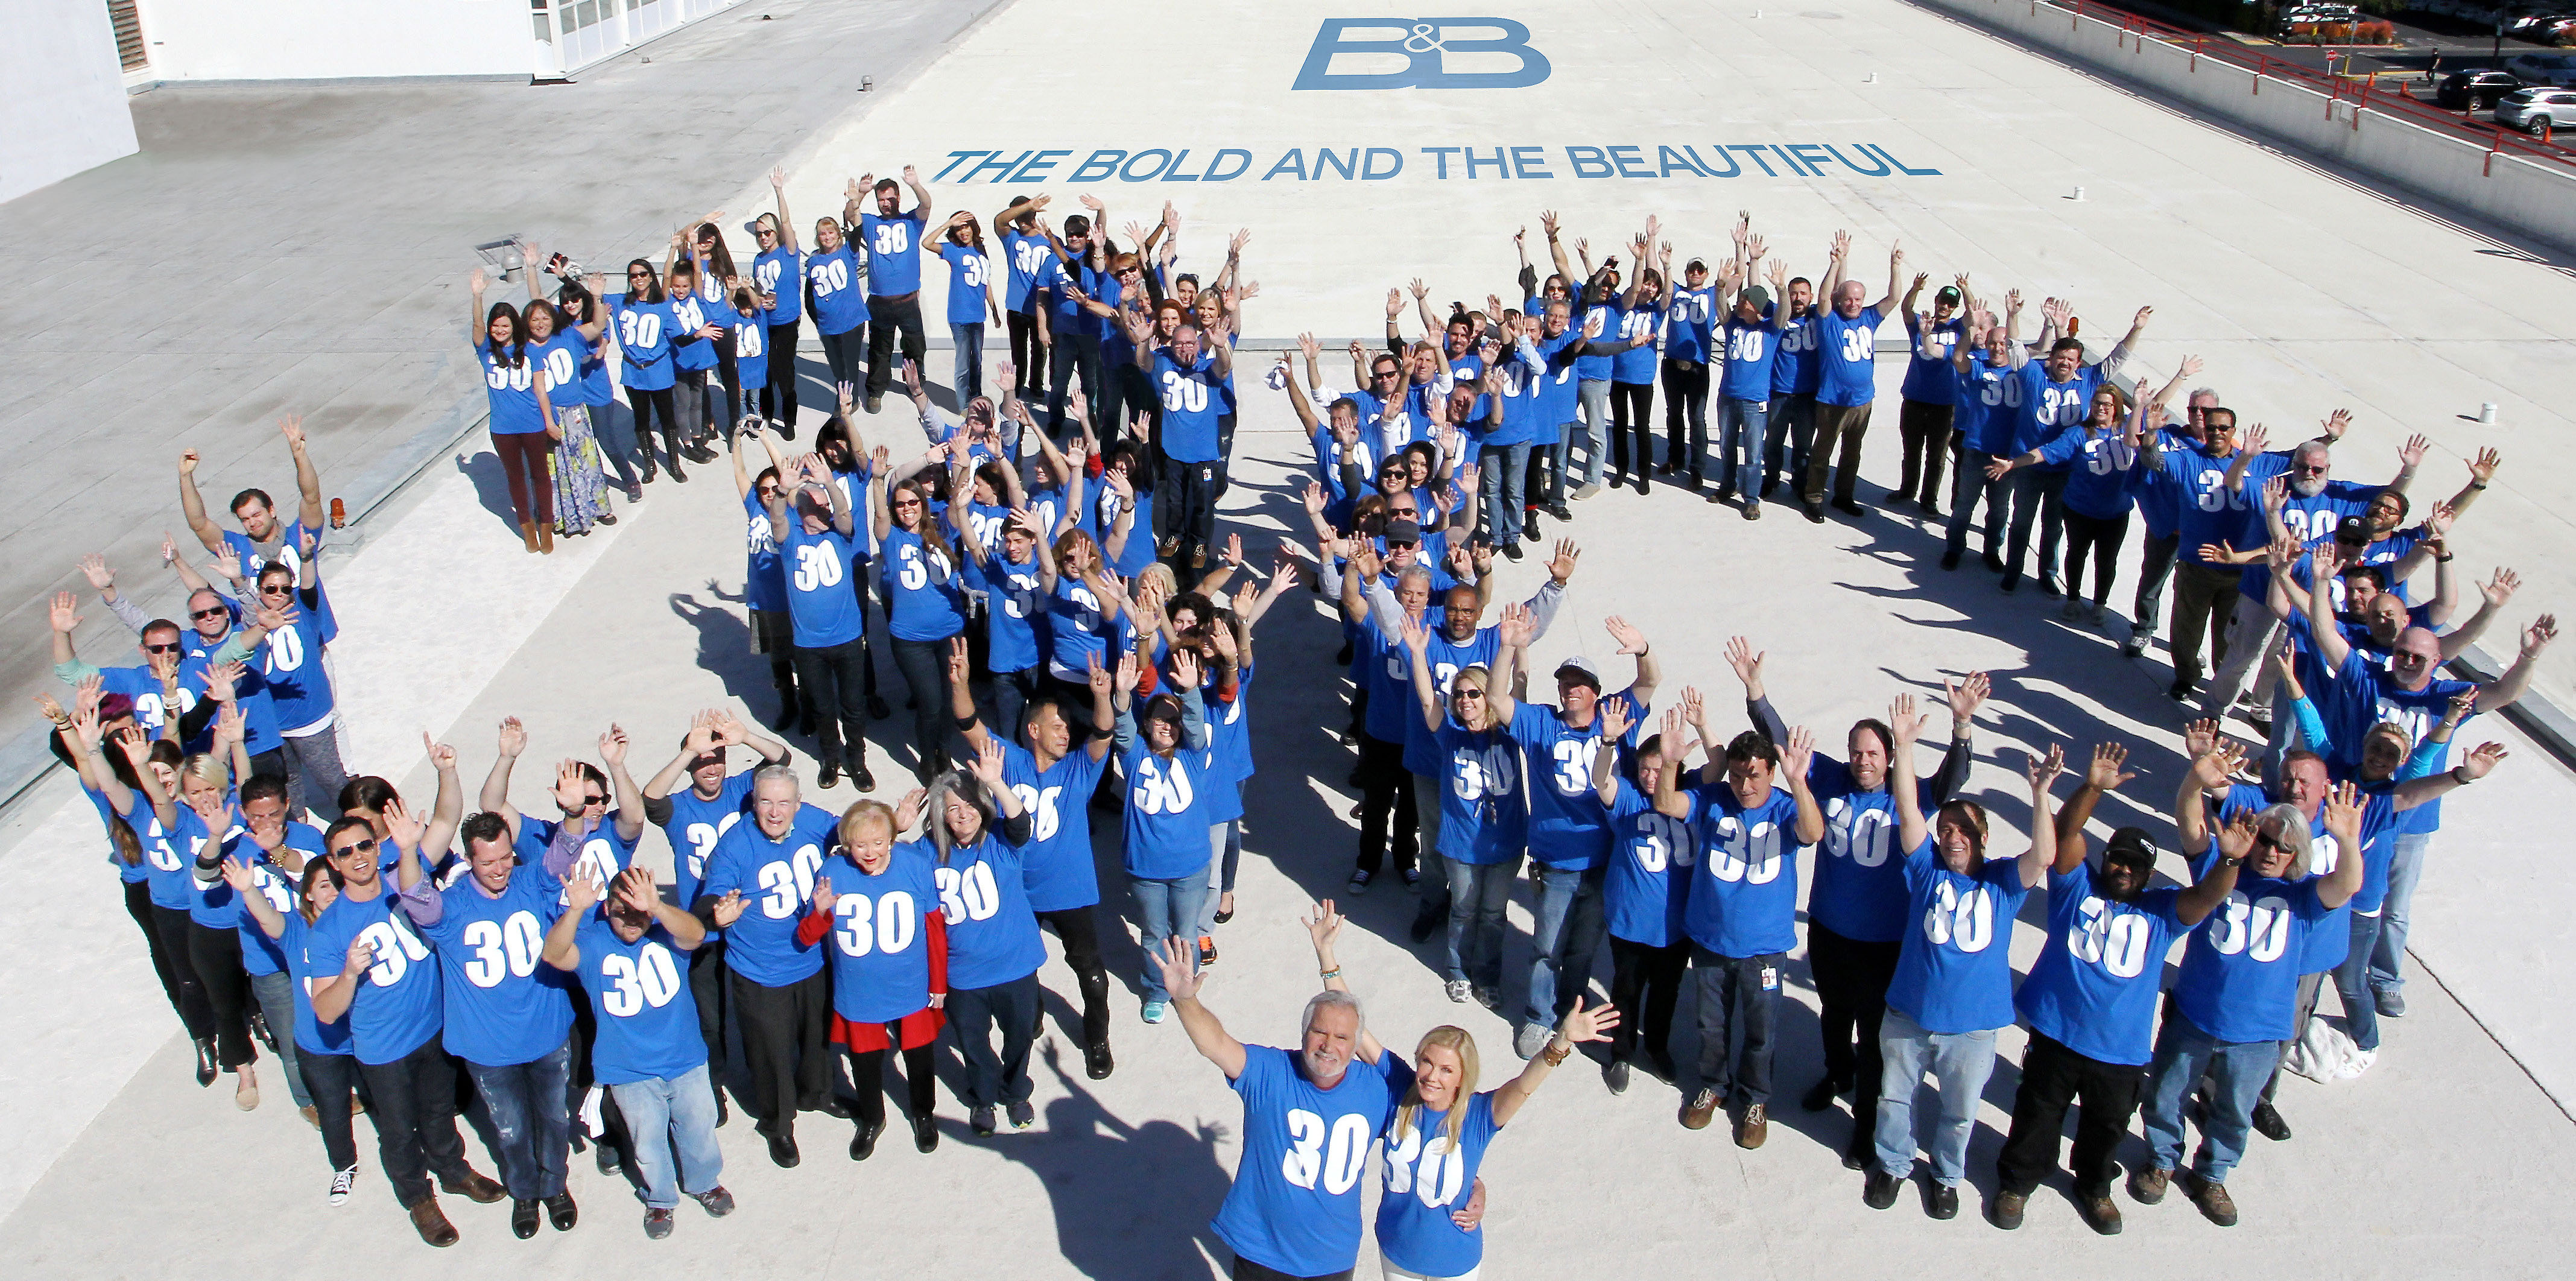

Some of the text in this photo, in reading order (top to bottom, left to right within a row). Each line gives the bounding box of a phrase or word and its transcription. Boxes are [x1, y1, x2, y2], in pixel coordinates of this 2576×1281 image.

[1291, 17, 1551, 90] B&B
[931, 144, 1944, 183] THE BOLD AND THE BEAUTIFUL
[875, 222, 908, 255] 30
[1015, 240, 1052, 276] 30
[811, 258, 848, 297] 30
[962, 254, 991, 287] 30
[618, 309, 661, 349] 30
[1670, 289, 1710, 324] 30
[1728, 324, 1764, 362] 30
[1782, 318, 1818, 352] 30
[1843, 324, 1873, 362] 30
[487, 355, 533, 392] 30
[1162, 370, 1209, 413] 30
[1981, 371, 2022, 408] 30
[2037, 388, 2081, 426] 30
[2084, 435, 2137, 476] 30
[794, 539, 843, 592] 30
[899, 543, 952, 591] 30
[1134, 756, 1194, 815] 30
[1453, 742, 1515, 801] 30
[1636, 812, 1698, 873] 30
[1709, 817, 1782, 885] 30
[1824, 797, 1892, 867] 30
[758, 843, 823, 920] 30
[934, 860, 999, 926] 30
[835, 891, 916, 958] 30
[1923, 879, 1992, 954] 30
[2067, 896, 2150, 979] 30
[2209, 888, 2290, 963] 30
[464, 909, 544, 988] 30
[602, 941, 681, 1018] 30
[1282, 1109, 1370, 1196] 30
[1382, 1119, 1464, 1209] 30
